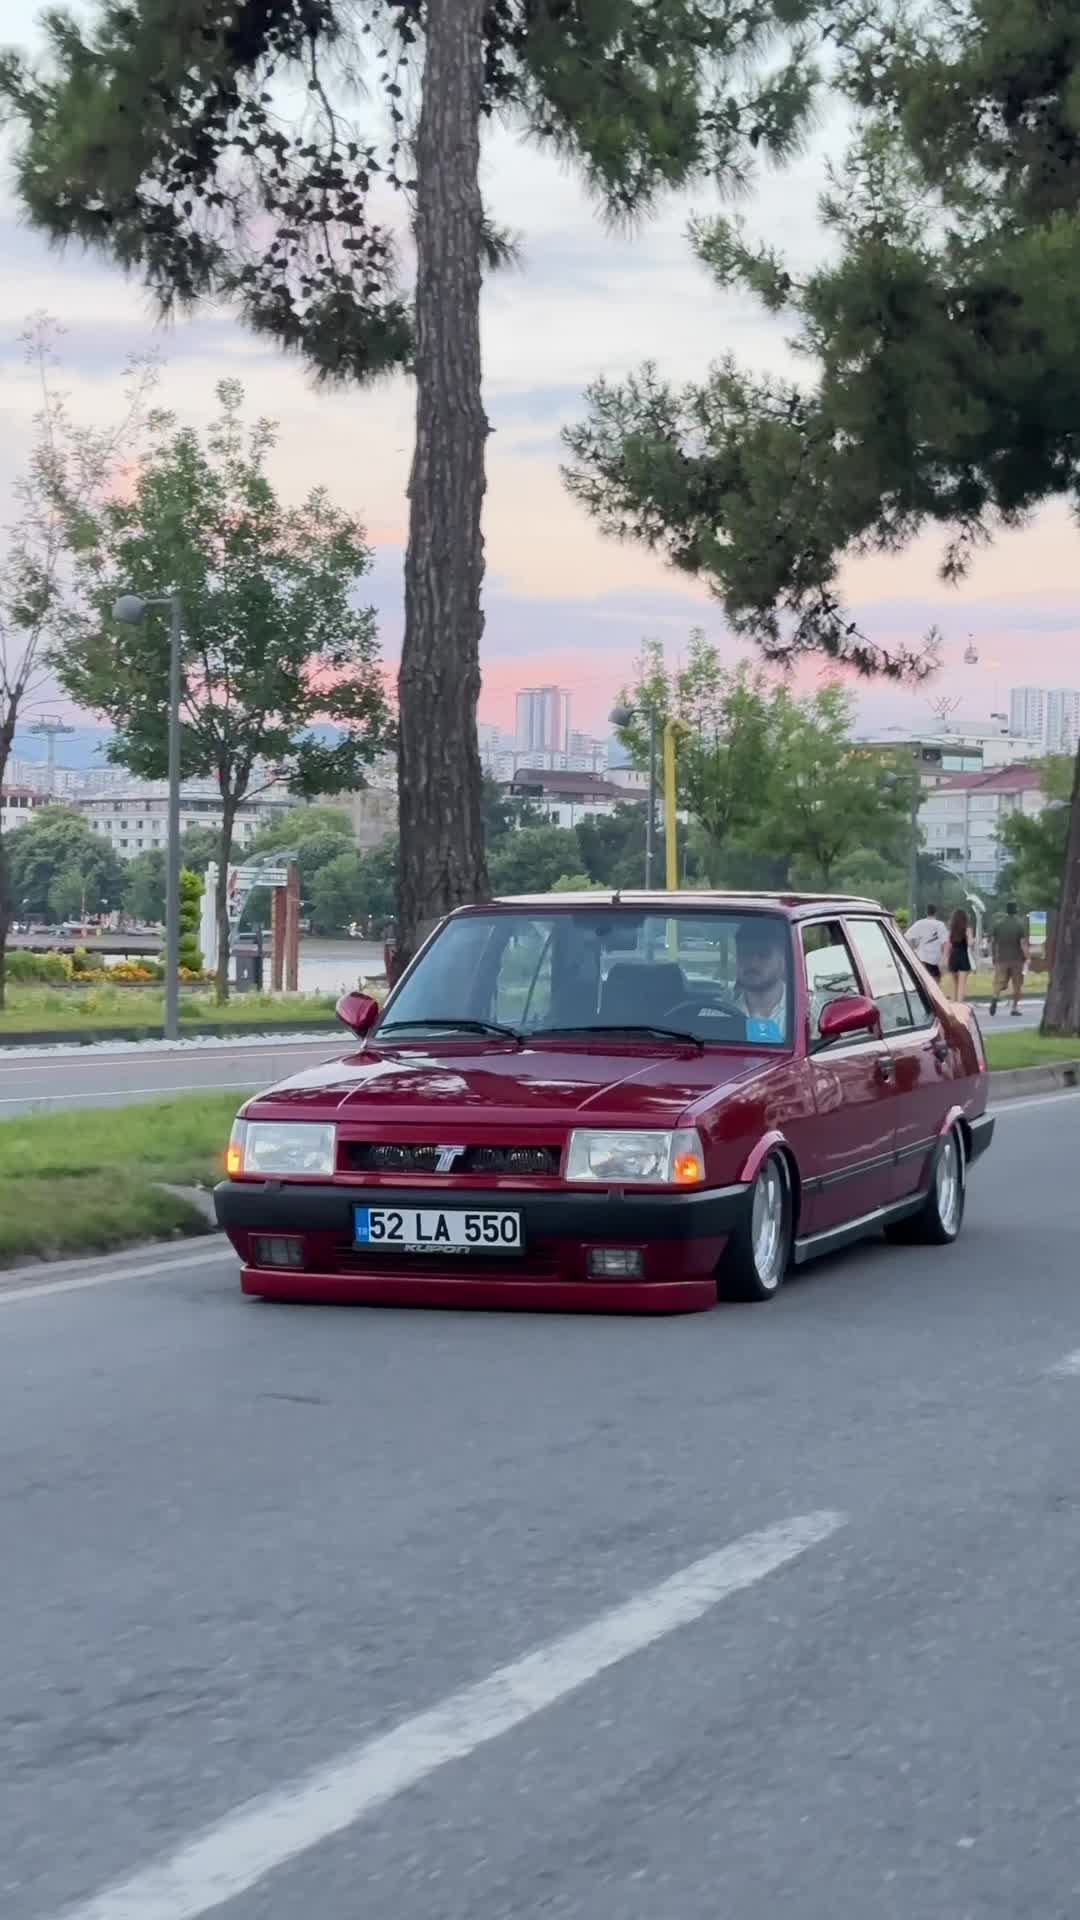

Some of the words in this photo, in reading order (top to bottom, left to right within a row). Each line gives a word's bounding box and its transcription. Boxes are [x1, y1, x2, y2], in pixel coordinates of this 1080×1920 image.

[370, 1211, 403, 1240] 52
[416, 1213, 450, 1241] LA
[465, 1215, 518, 1243] 550
